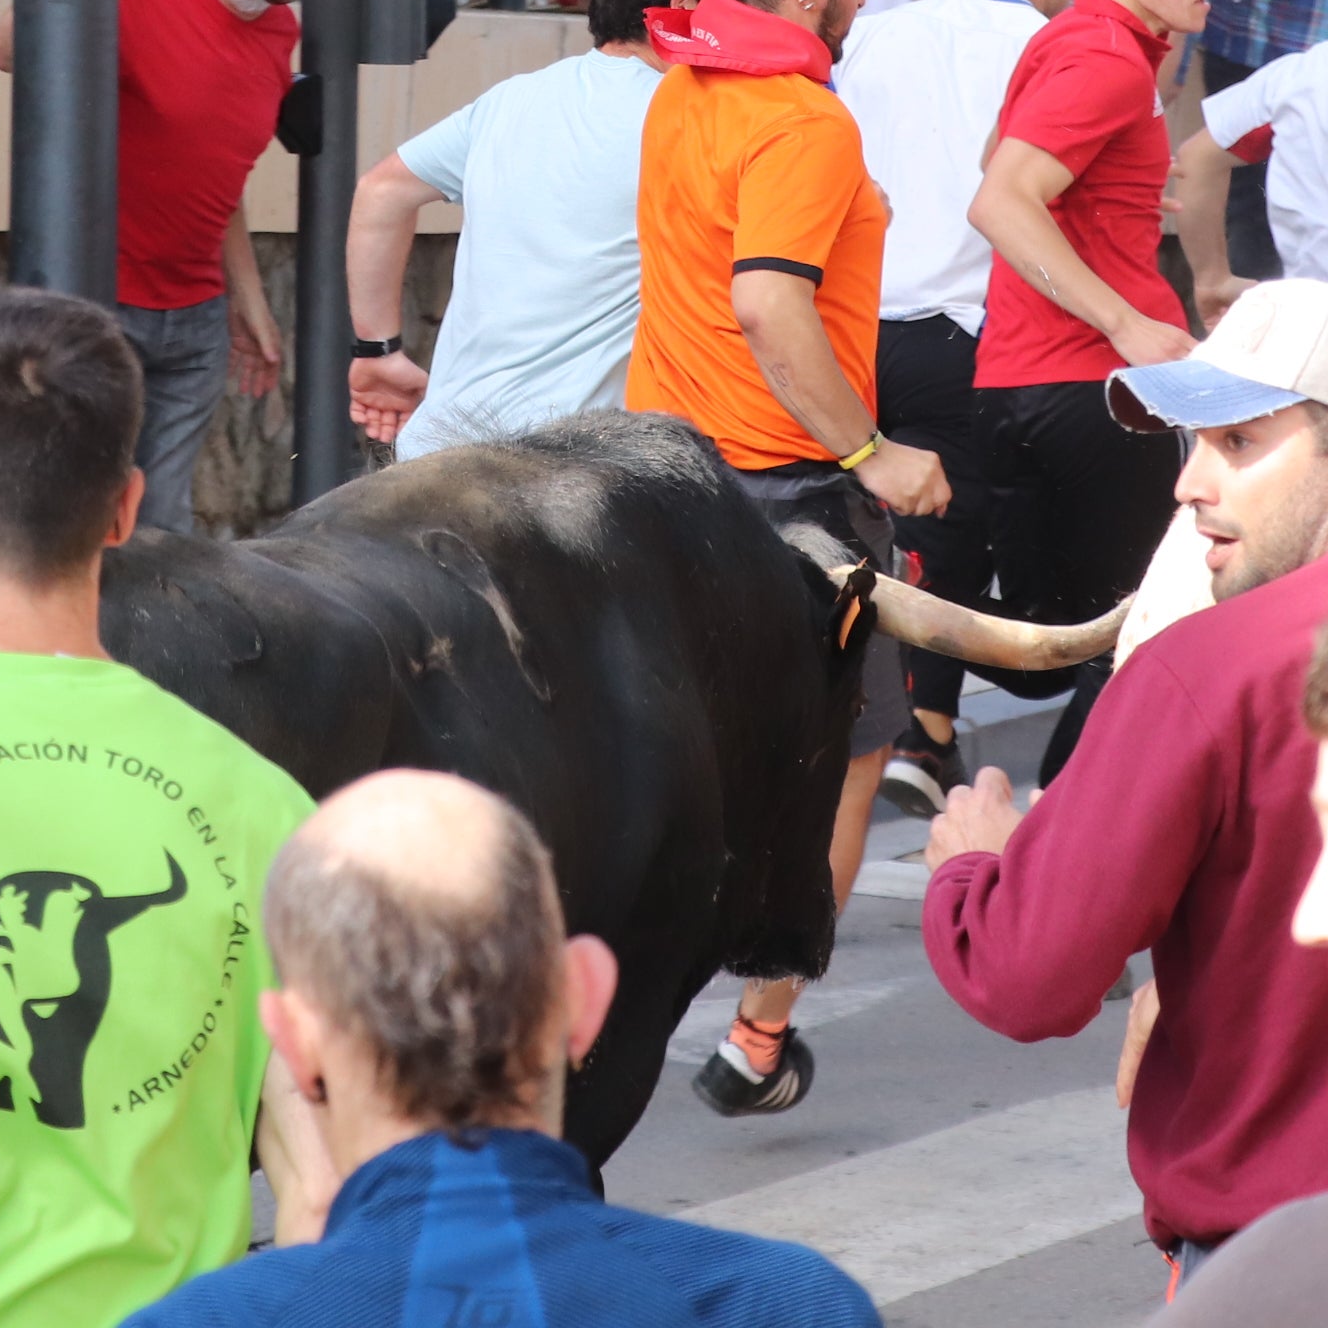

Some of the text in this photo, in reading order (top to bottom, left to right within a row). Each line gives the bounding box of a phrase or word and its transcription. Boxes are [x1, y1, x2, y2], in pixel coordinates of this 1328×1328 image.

[105, 749, 183, 801] TORO
[187, 807, 217, 845] EN
[214, 856, 237, 890] LA
[221, 902, 250, 992] CALLE
[128, 1012, 216, 1112] ARNEDO
